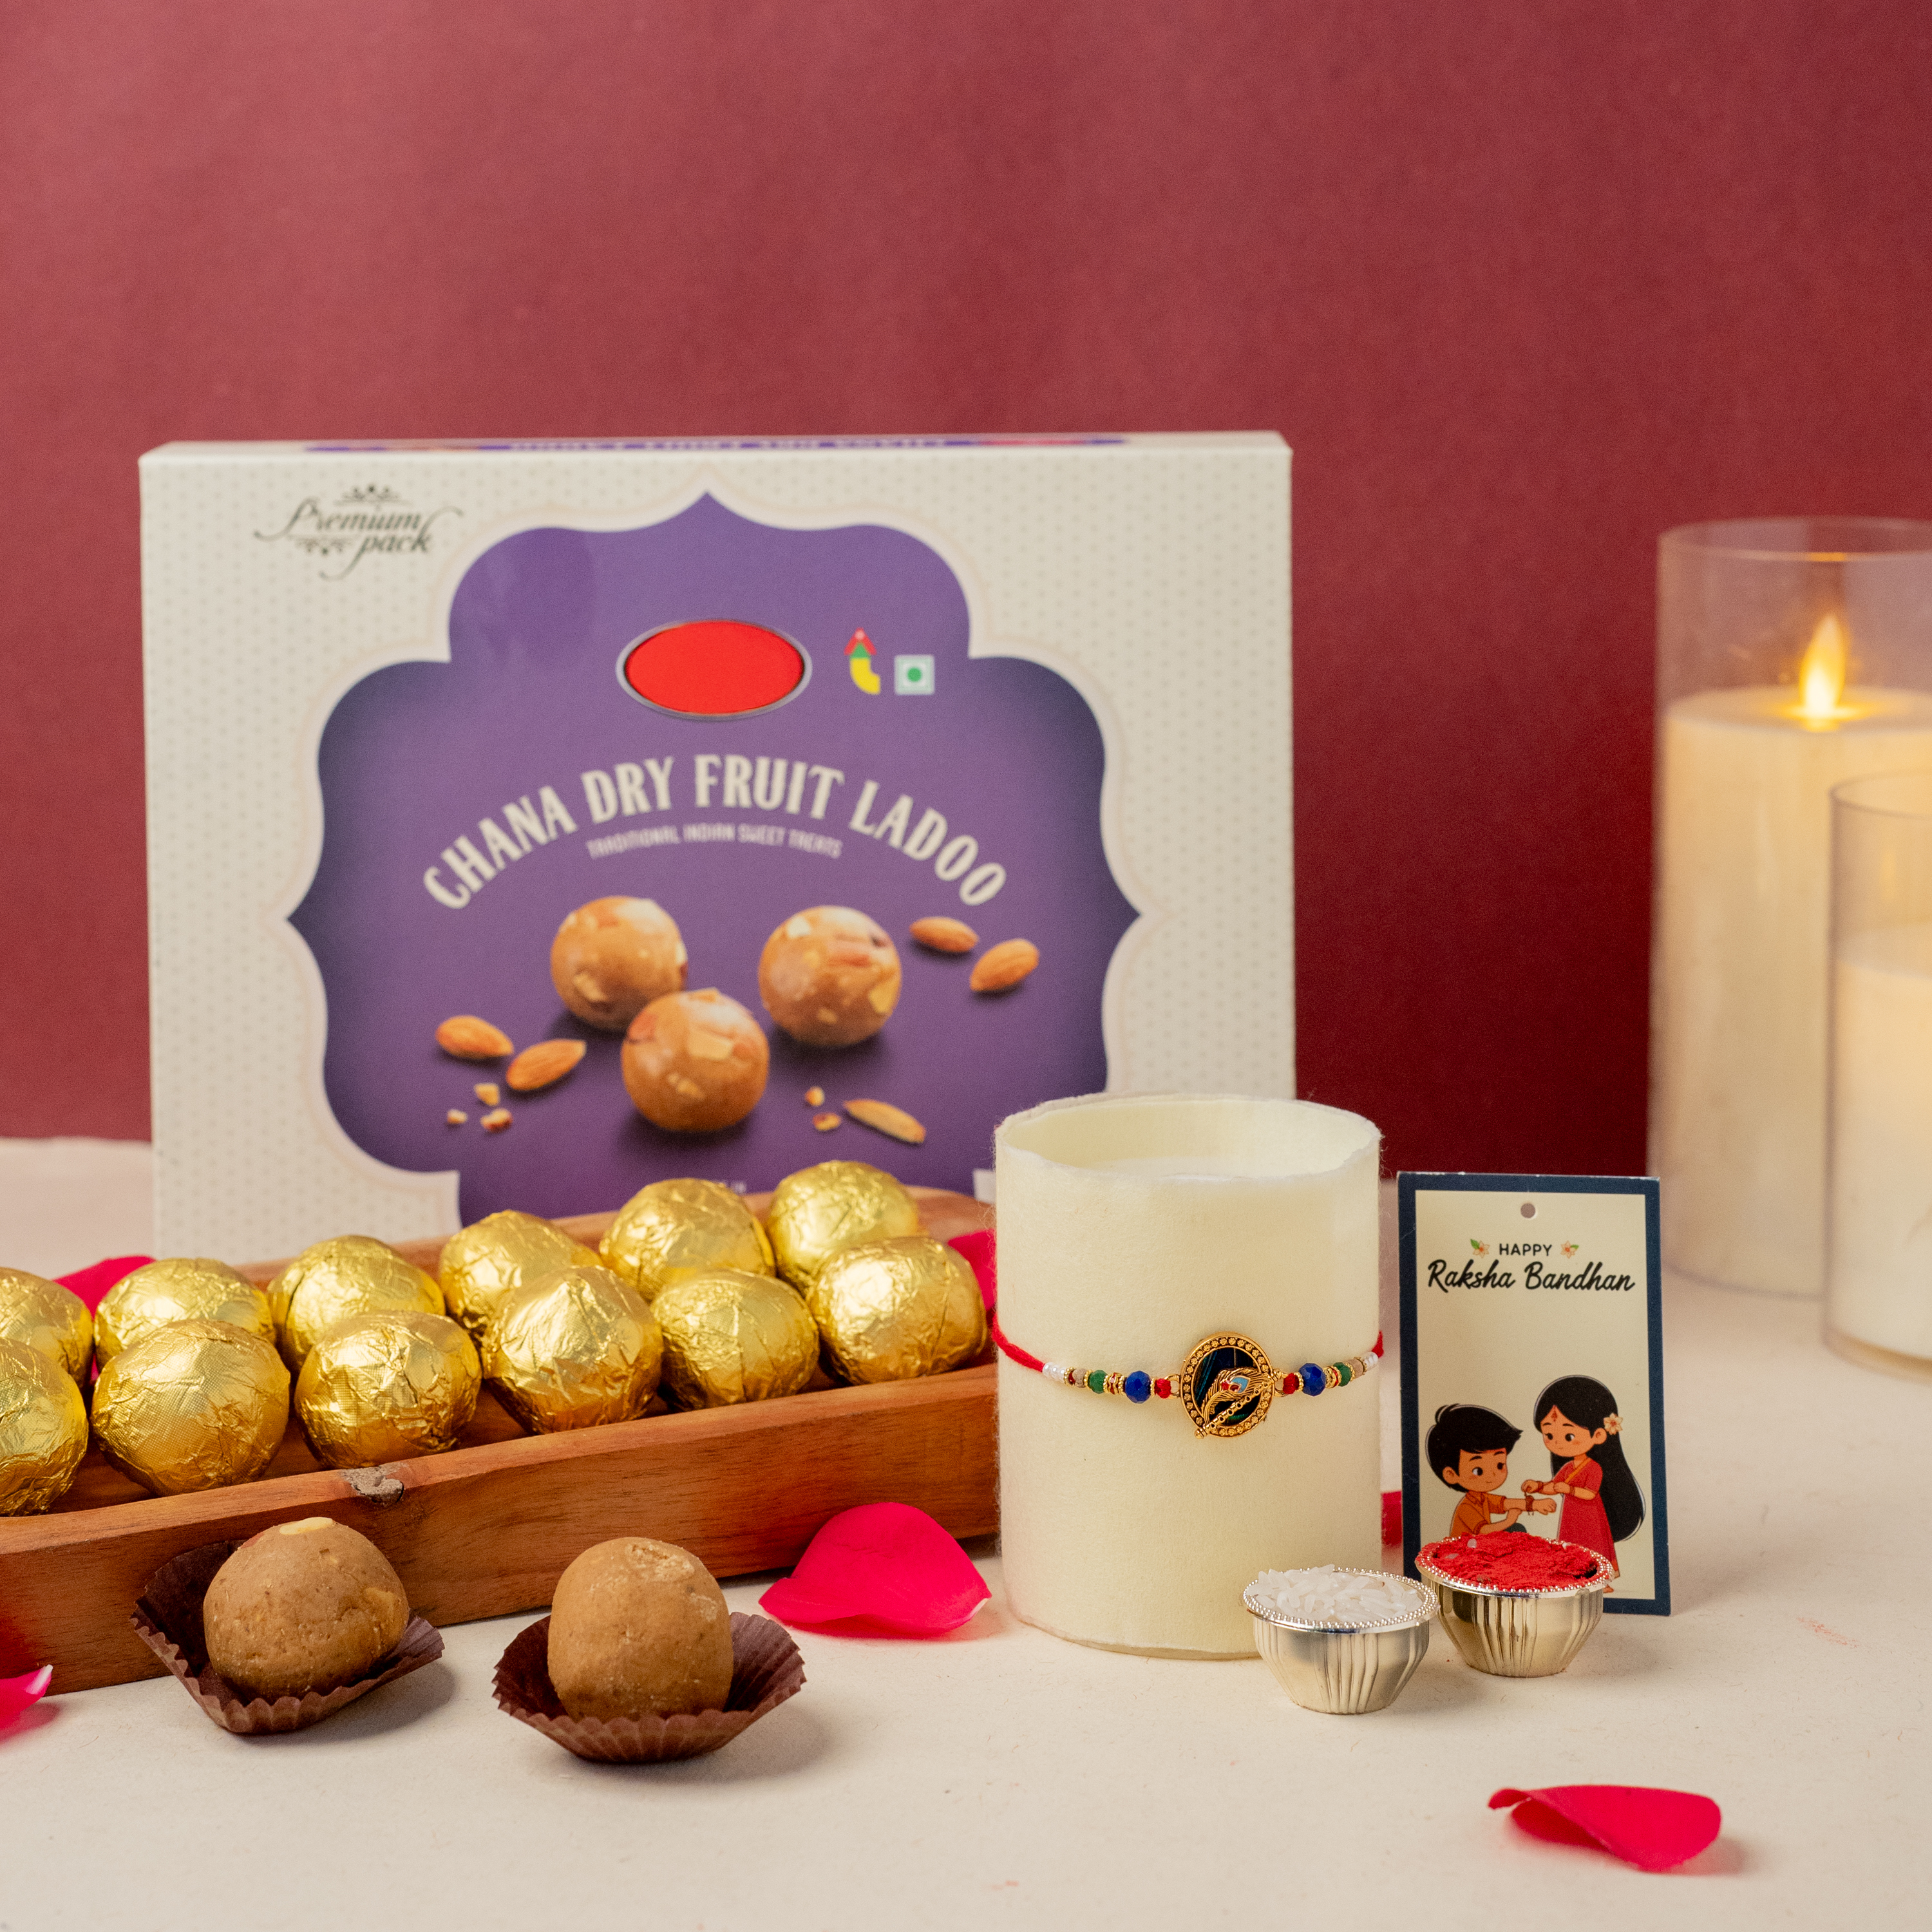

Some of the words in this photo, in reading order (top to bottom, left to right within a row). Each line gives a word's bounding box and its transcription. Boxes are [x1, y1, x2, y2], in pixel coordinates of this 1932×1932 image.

[254, 497, 422, 542] Premium
[423, 785, 578, 909] CHANA
[581, 755, 675, 824] DRY
[694, 753, 846, 820] FRUIT
[848, 779, 1007, 906] LADOO
[737, 823, 786, 847] SWEET
[788, 828, 843, 859] TREATS
[1499, 1243, 1552, 1256] HAPPY
[1427, 1259, 1515, 1293] Raksha
[1524, 1262, 1636, 1291] Bandhan
